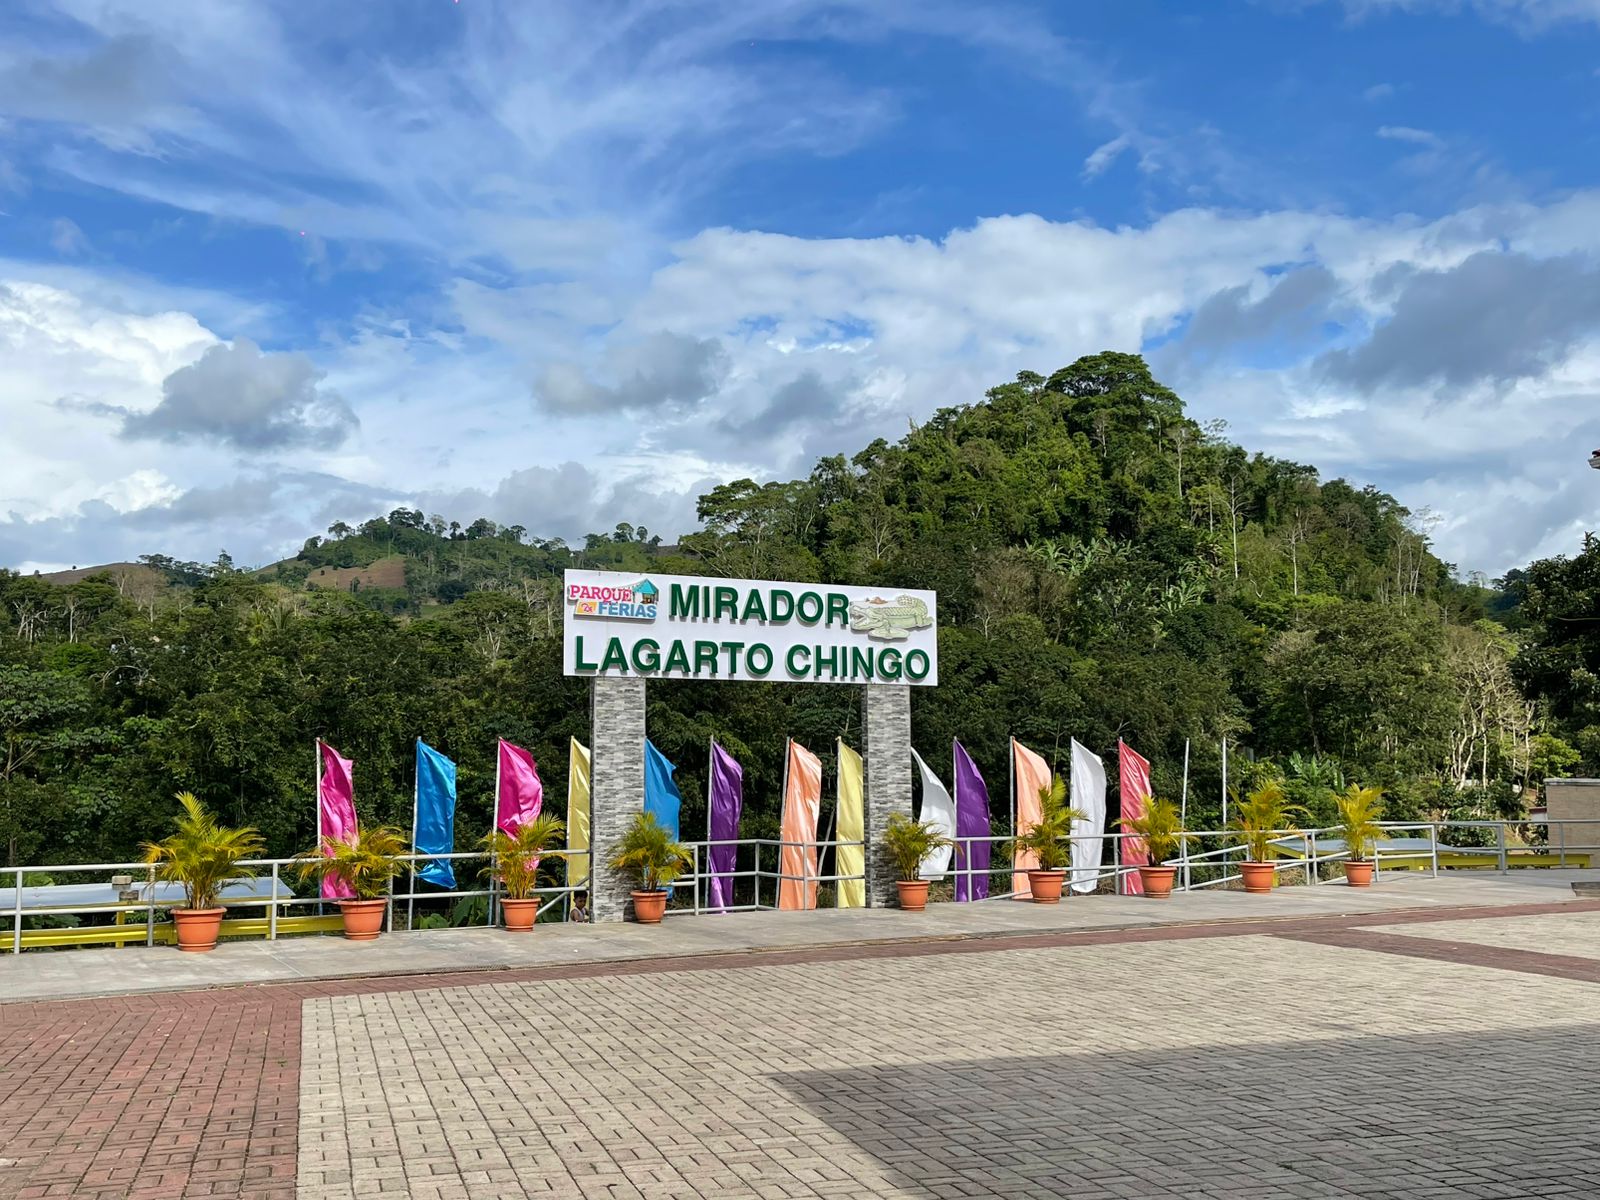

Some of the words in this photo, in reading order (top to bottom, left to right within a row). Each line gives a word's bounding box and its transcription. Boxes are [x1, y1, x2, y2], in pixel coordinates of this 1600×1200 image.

[570, 584, 632, 605] PARQUE
[598, 602, 657, 618] FERIAS
[670, 583, 848, 625] MIRADOR
[575, 635, 773, 676] LAGARTO
[786, 644, 930, 680] CHINGO
